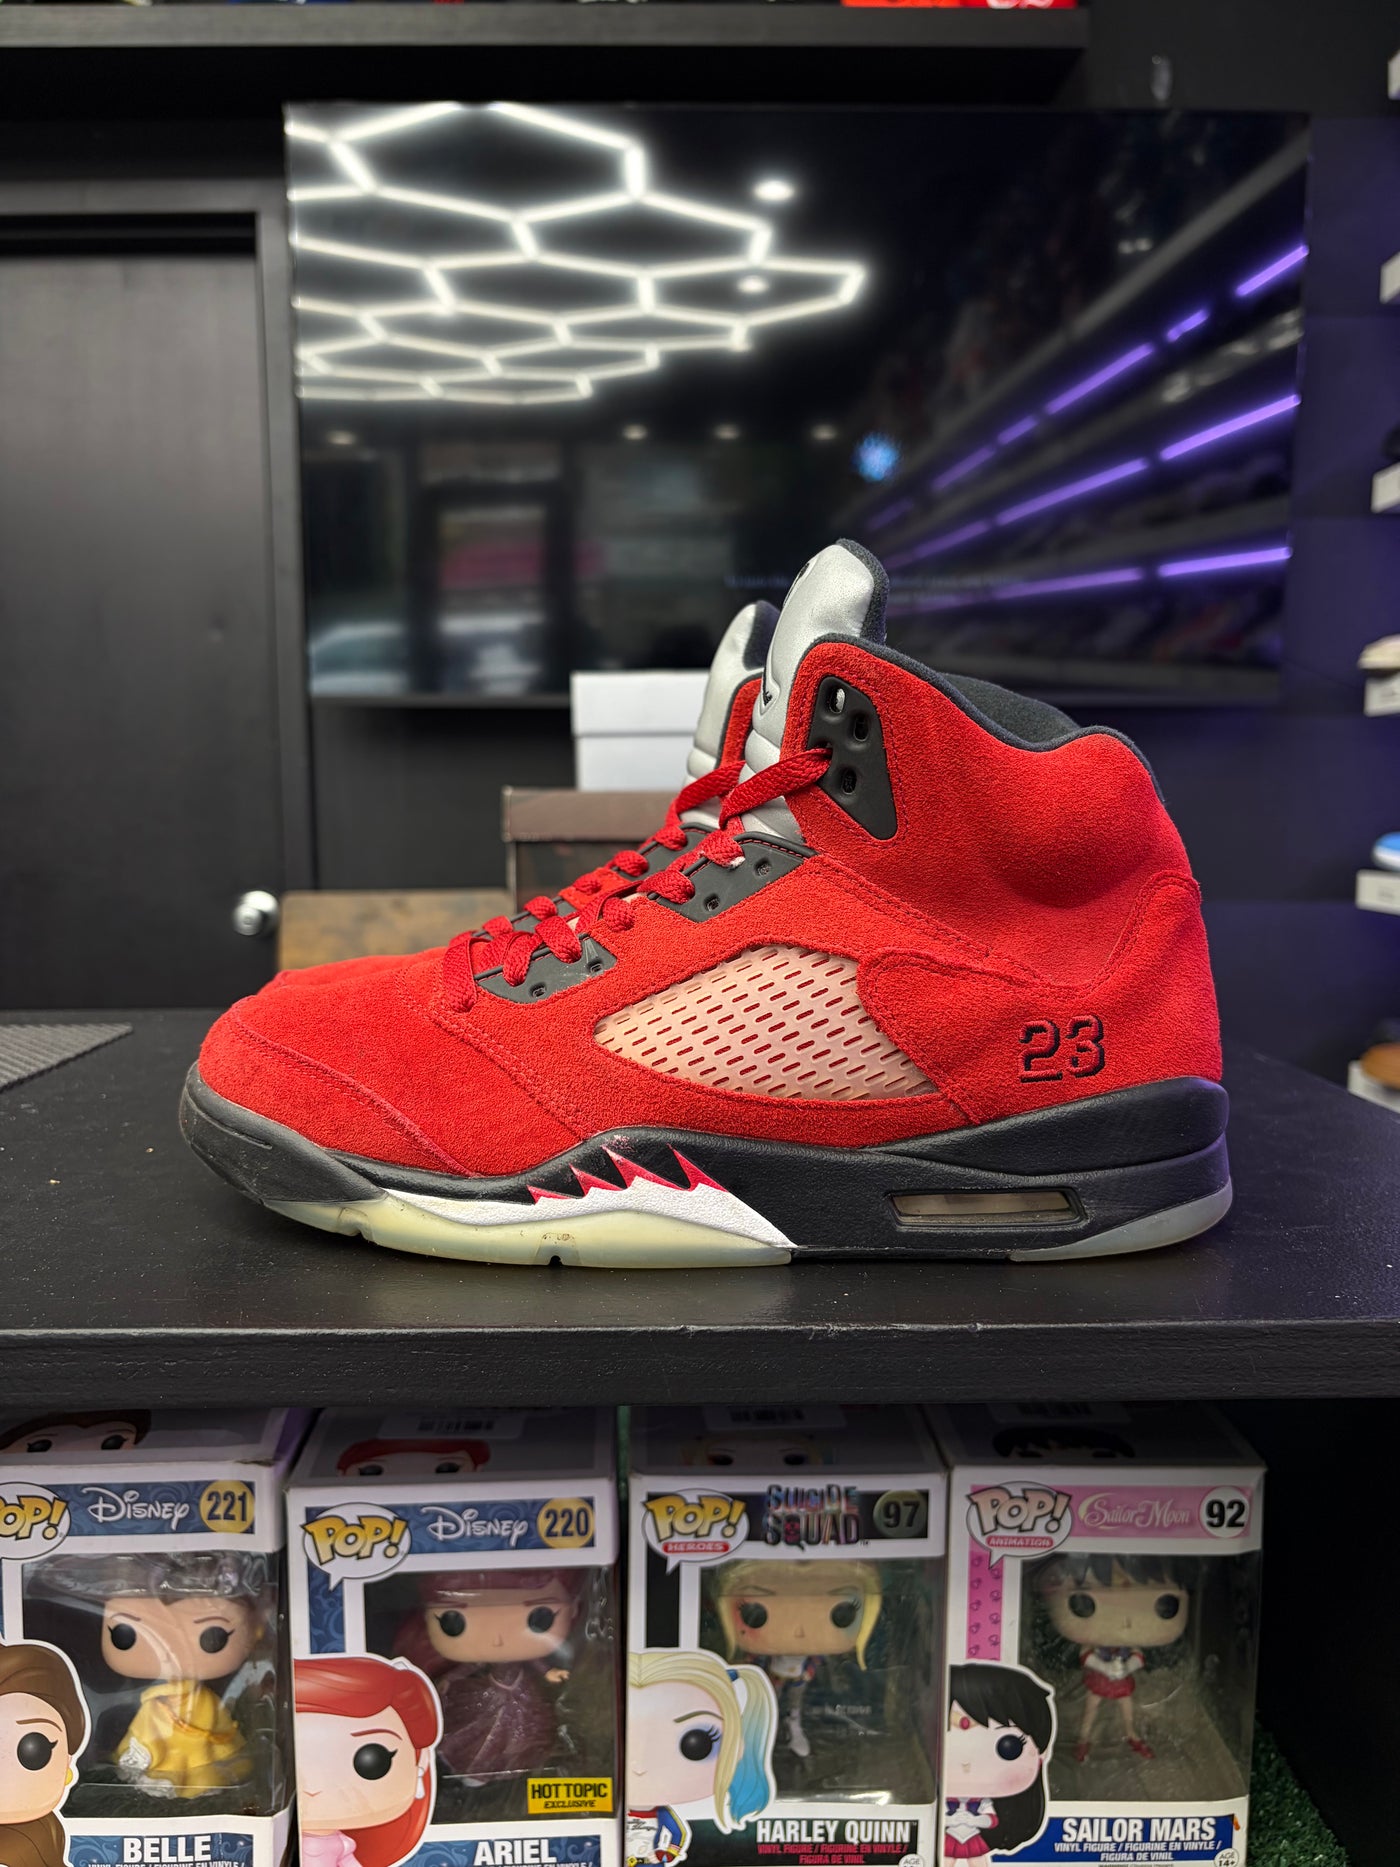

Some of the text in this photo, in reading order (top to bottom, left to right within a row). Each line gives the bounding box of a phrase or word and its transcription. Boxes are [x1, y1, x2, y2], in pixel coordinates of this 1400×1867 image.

[1018, 1015, 1105, 1083] 23
[0, 1495, 68, 1540] OP!
[207, 1491, 248, 1522] 221
[645, 1495, 746, 1542] POP!
[883, 1501, 920, 1529] 97
[966, 1486, 1073, 1536] POP!
[1084, 1499, 1190, 1528] Sailor Moon
[1206, 1499, 1246, 1528] 92
[544, 1508, 590, 1538] 220
[764, 1512, 860, 1552] SQUAD
[301, 1515, 409, 1565] POP!
[667, 1543, 724, 1552] HEROES
[989, 1536, 1051, 1547] ANIMATION
[531, 1782, 608, 1799] HOT TOPIC
[544, 1800, 597, 1809] EXCLUSIVE
[756, 1820, 910, 1846] HARLEY QUINN
[1062, 1817, 1217, 1843] SAILOR MARS
[123, 1835, 212, 1863] BELLE
[473, 1839, 557, 1866] ARIEL
[1054, 1843, 1081, 1852] VINYL
[1083, 1843, 1116, 1852] FIGURE
[1124, 1842, 1167, 1852] FIGURINE
[1168, 1842, 1181, 1851] EN
[1183, 1841, 1215, 1850] VINYLE
[1101, 1852, 1174, 1862] FIGURA DE VINIL
